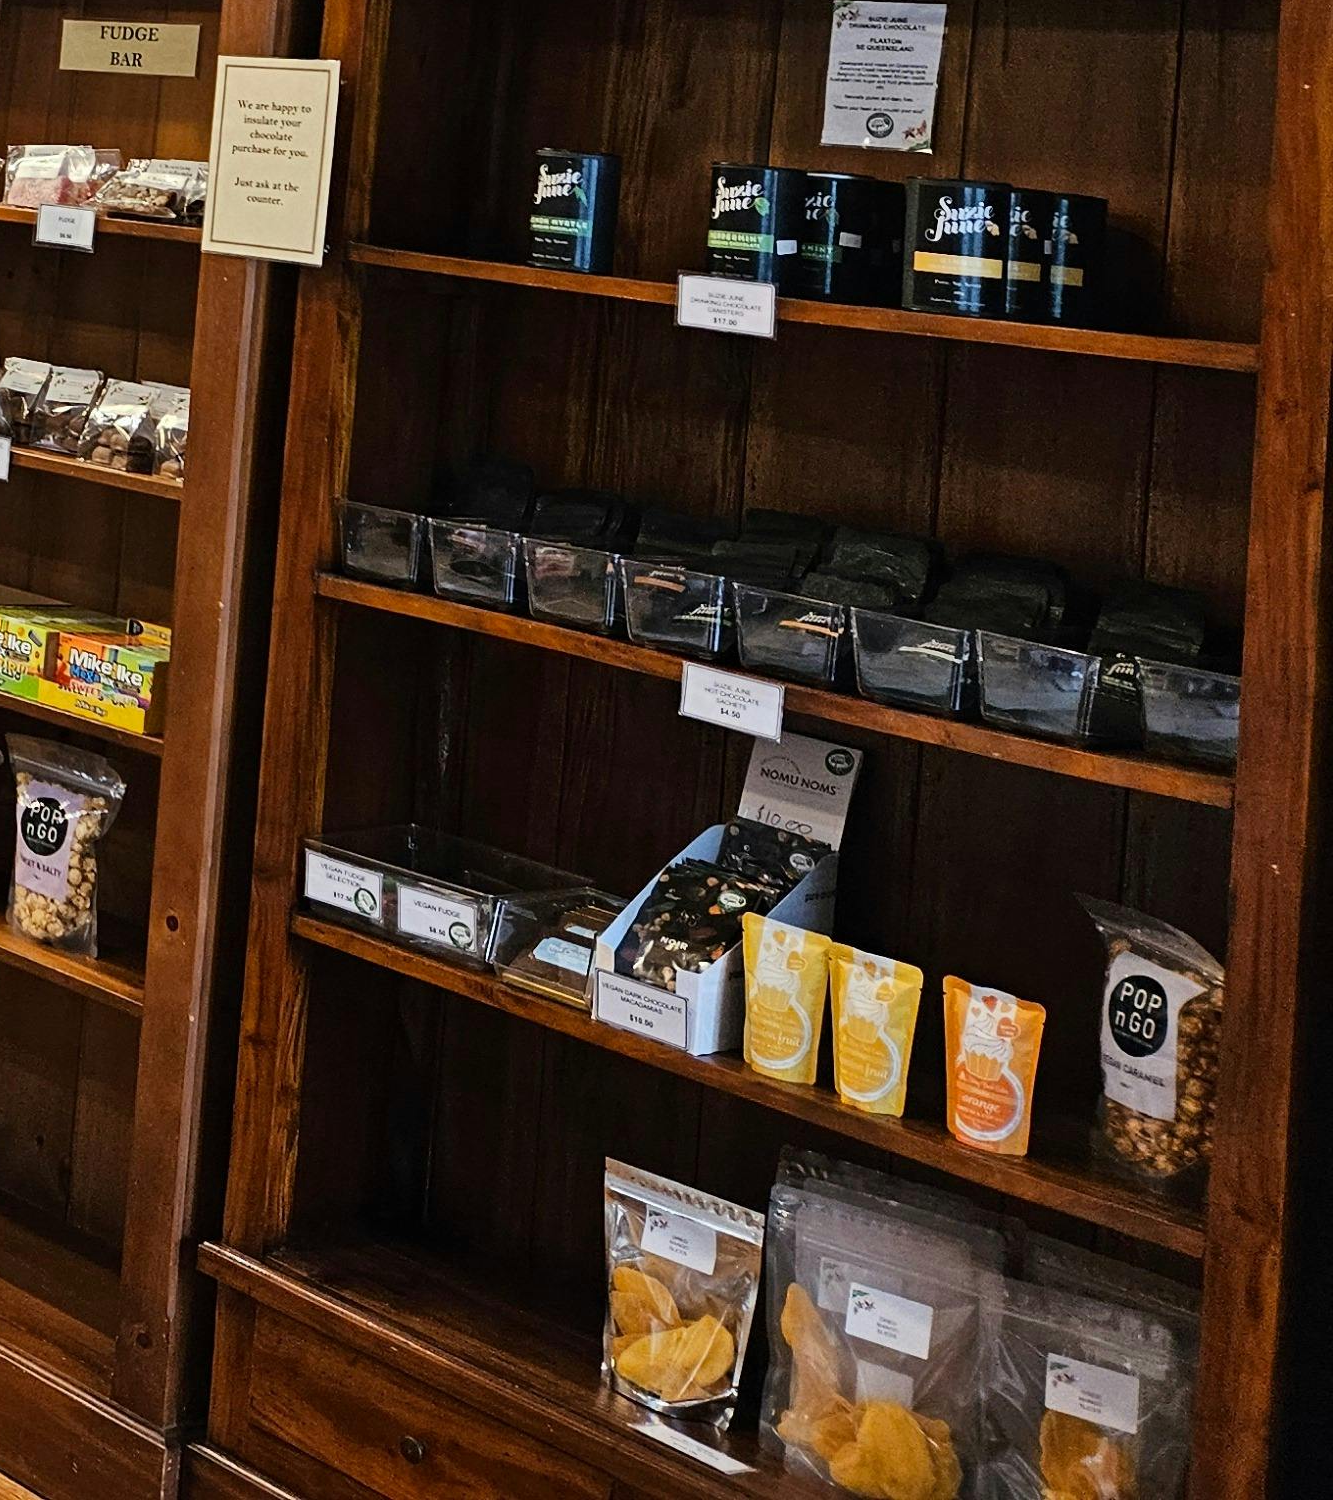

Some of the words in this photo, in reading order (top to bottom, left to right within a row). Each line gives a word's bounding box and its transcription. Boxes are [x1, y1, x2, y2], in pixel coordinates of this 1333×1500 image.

[100, 25, 159, 43] FUDGE
[110, 51, 143, 68] BAR
[237, 99, 253, 111] We
[255, 102, 270, 111] are
[271, 101, 299, 116] happy
[301, 105, 312, 114] to
[243, 114, 279, 127] insulate
[280, 120, 302, 130] your
[249, 130, 293, 143] chocolate
[231, 144, 271, 156] purchase
[273, 146, 287, 156] for
[288, 150, 309, 160] you.
[234, 176, 253, 188] Just
[255, 180, 270, 189] ask
[273, 182, 282, 192] at
[284, 182, 300, 193] the
[538, 163, 584, 186] Suzie
[533, 181, 573, 205] June
[715, 175, 765, 200] Suzie
[246, 194, 284, 207] counter.
[711, 194, 756, 220] June
[933, 195, 995, 222] Suzie
[924, 214, 986, 242] June
[7, 633, 33, 656] Ike
[69, 647, 114, 674] Mike
[117, 664, 144, 688] Ike
[760, 767, 799, 785] NOMU
[800, 777, 837, 796] NOMS
[30, 804, 62, 824] POP
[42, 864, 62, 878] SALTY
[320, 861, 343, 875] VEGAN
[344, 870, 366, 882] FUDGE
[325, 872, 362, 888] SELECTION
[413, 899, 437, 912] VEGAN
[438, 906, 461, 919] FUDGE
[660, 935, 689, 951] NOIR
[601, 981, 624, 994] VEGAN
[624, 990, 643, 1001] DARK
[643, 995, 683, 1014] CHOCOLATE
[620, 996, 663, 1015] MACADAMIAS
[1119, 981, 1162, 1014] POP
